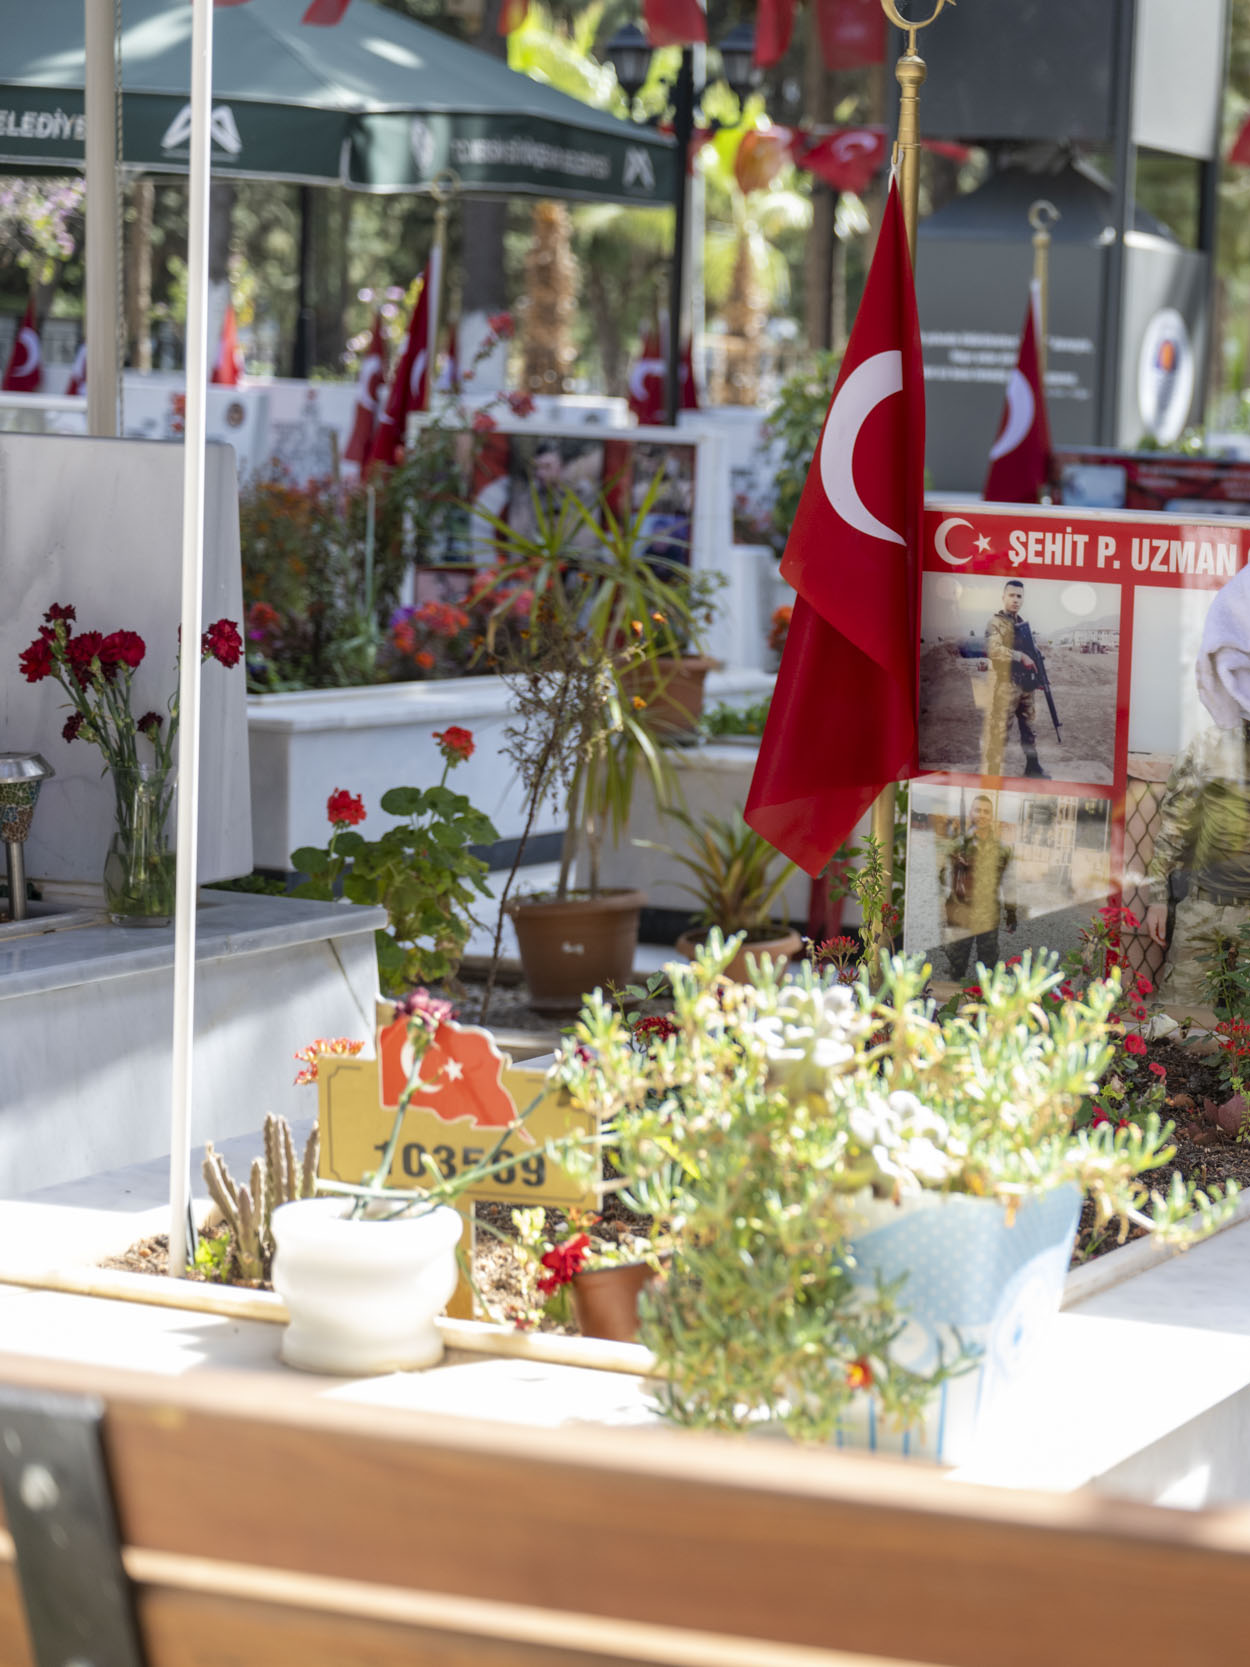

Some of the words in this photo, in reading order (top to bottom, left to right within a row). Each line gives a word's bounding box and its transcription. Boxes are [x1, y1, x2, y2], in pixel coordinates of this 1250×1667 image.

[1008, 526, 1089, 567] ŞEHİT
[1097, 536, 1120, 569] P.
[1131, 537, 1237, 577] UZMAN
